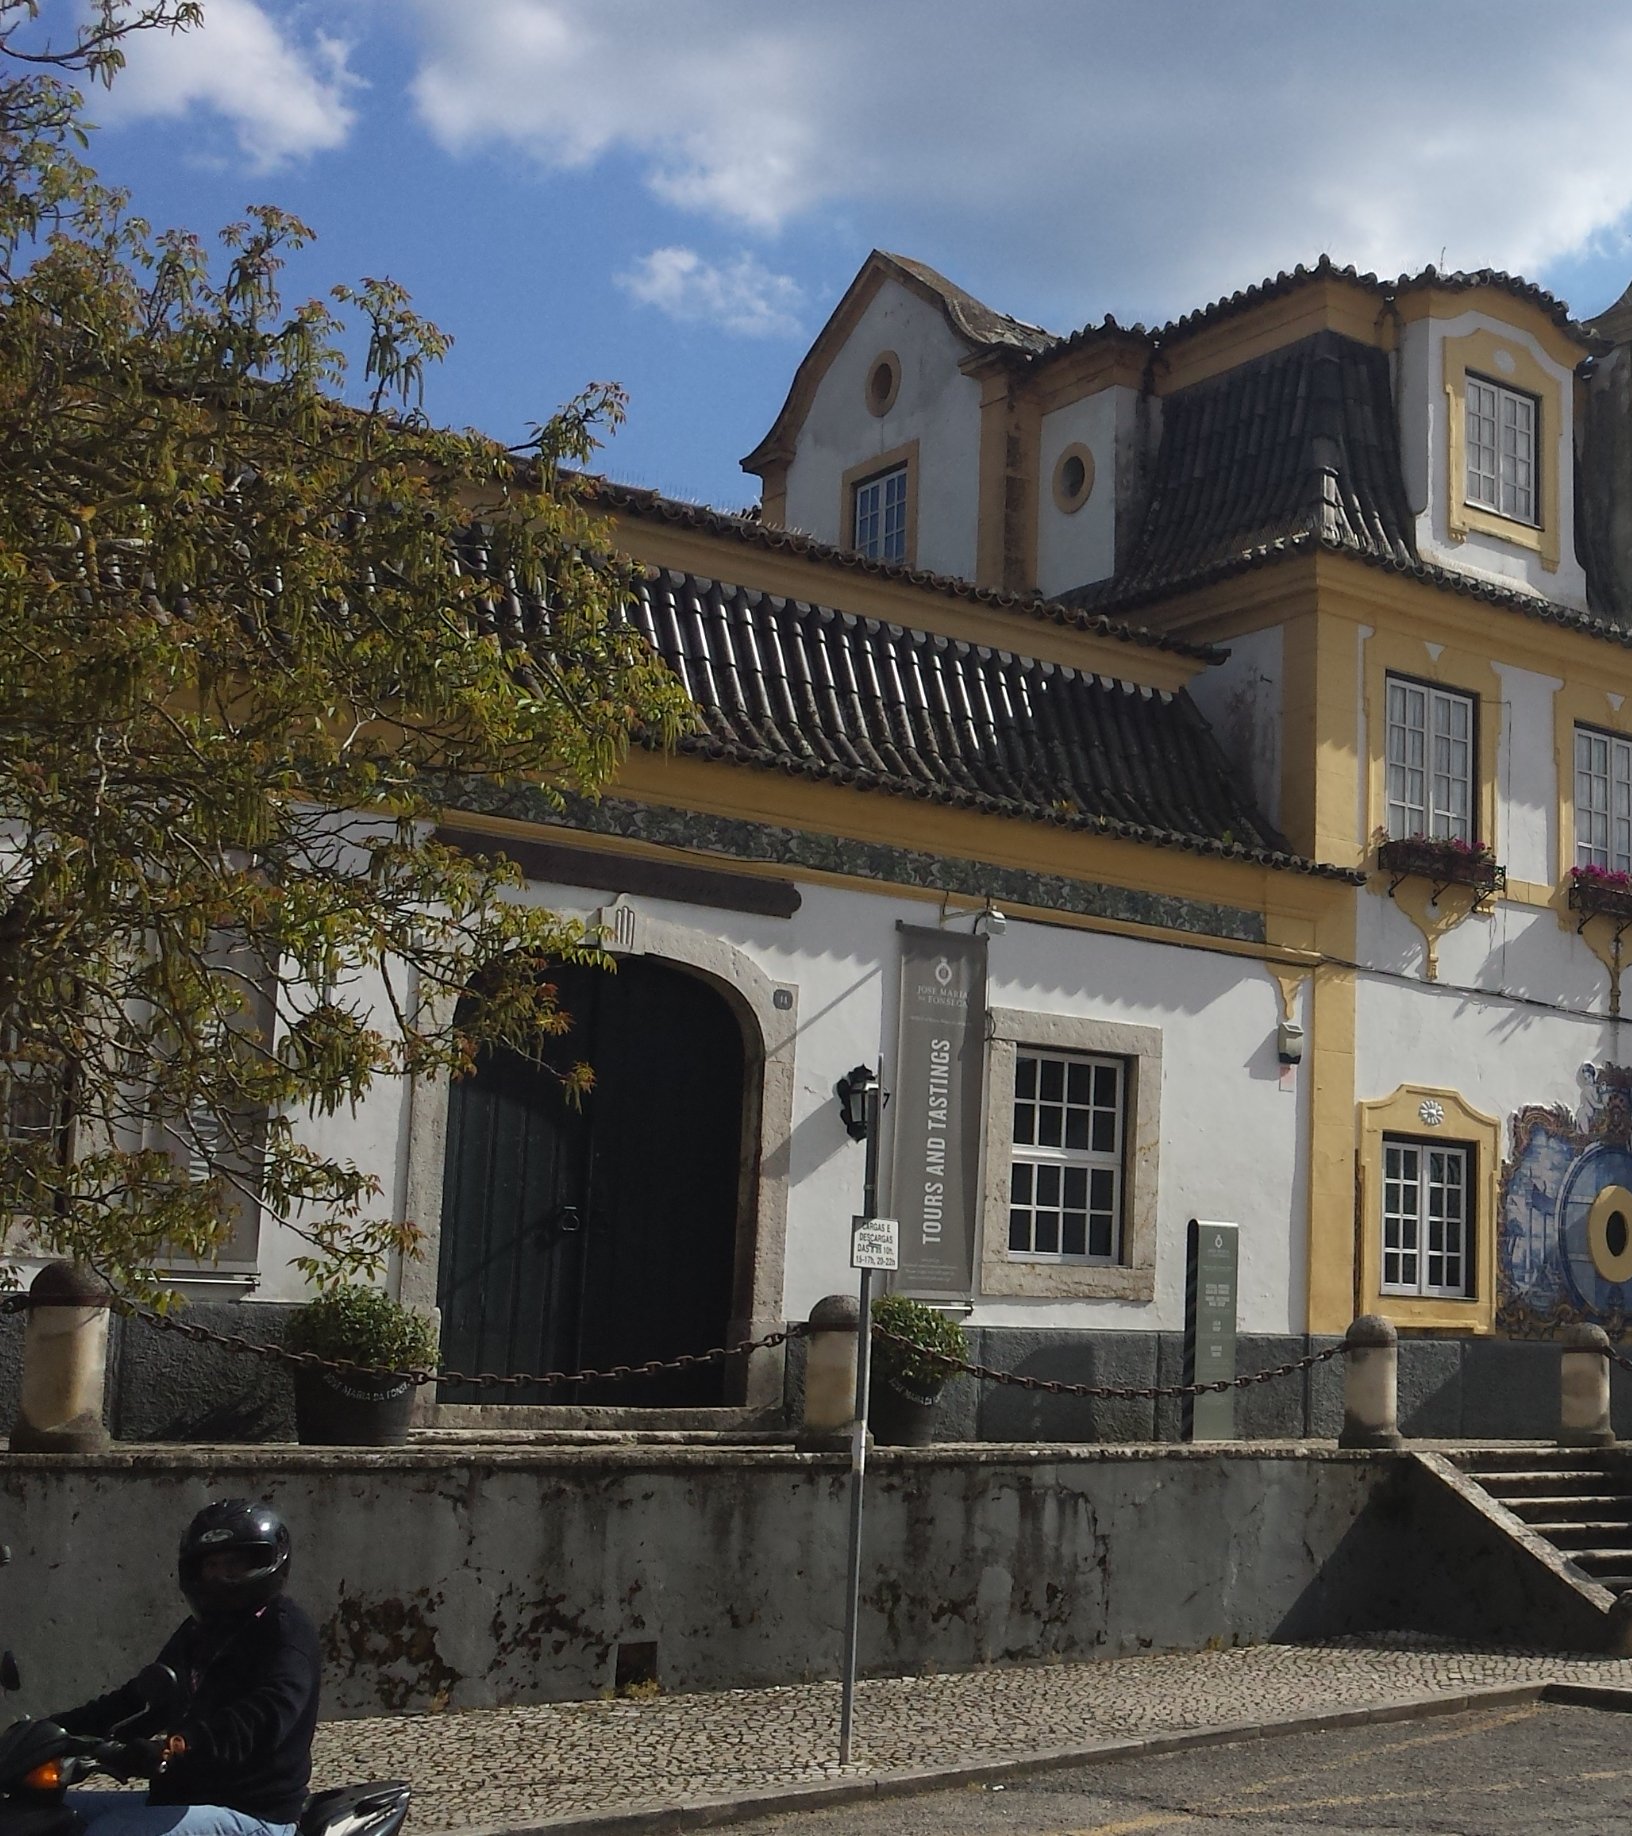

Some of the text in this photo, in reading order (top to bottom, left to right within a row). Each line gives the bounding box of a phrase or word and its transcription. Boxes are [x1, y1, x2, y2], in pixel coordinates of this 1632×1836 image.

[922, 1039, 951, 1245] TOURS AND TASTINGS
[862, 1222, 891, 1233] CARGAS E
[859, 1233, 893, 1244] DESCARGAS
